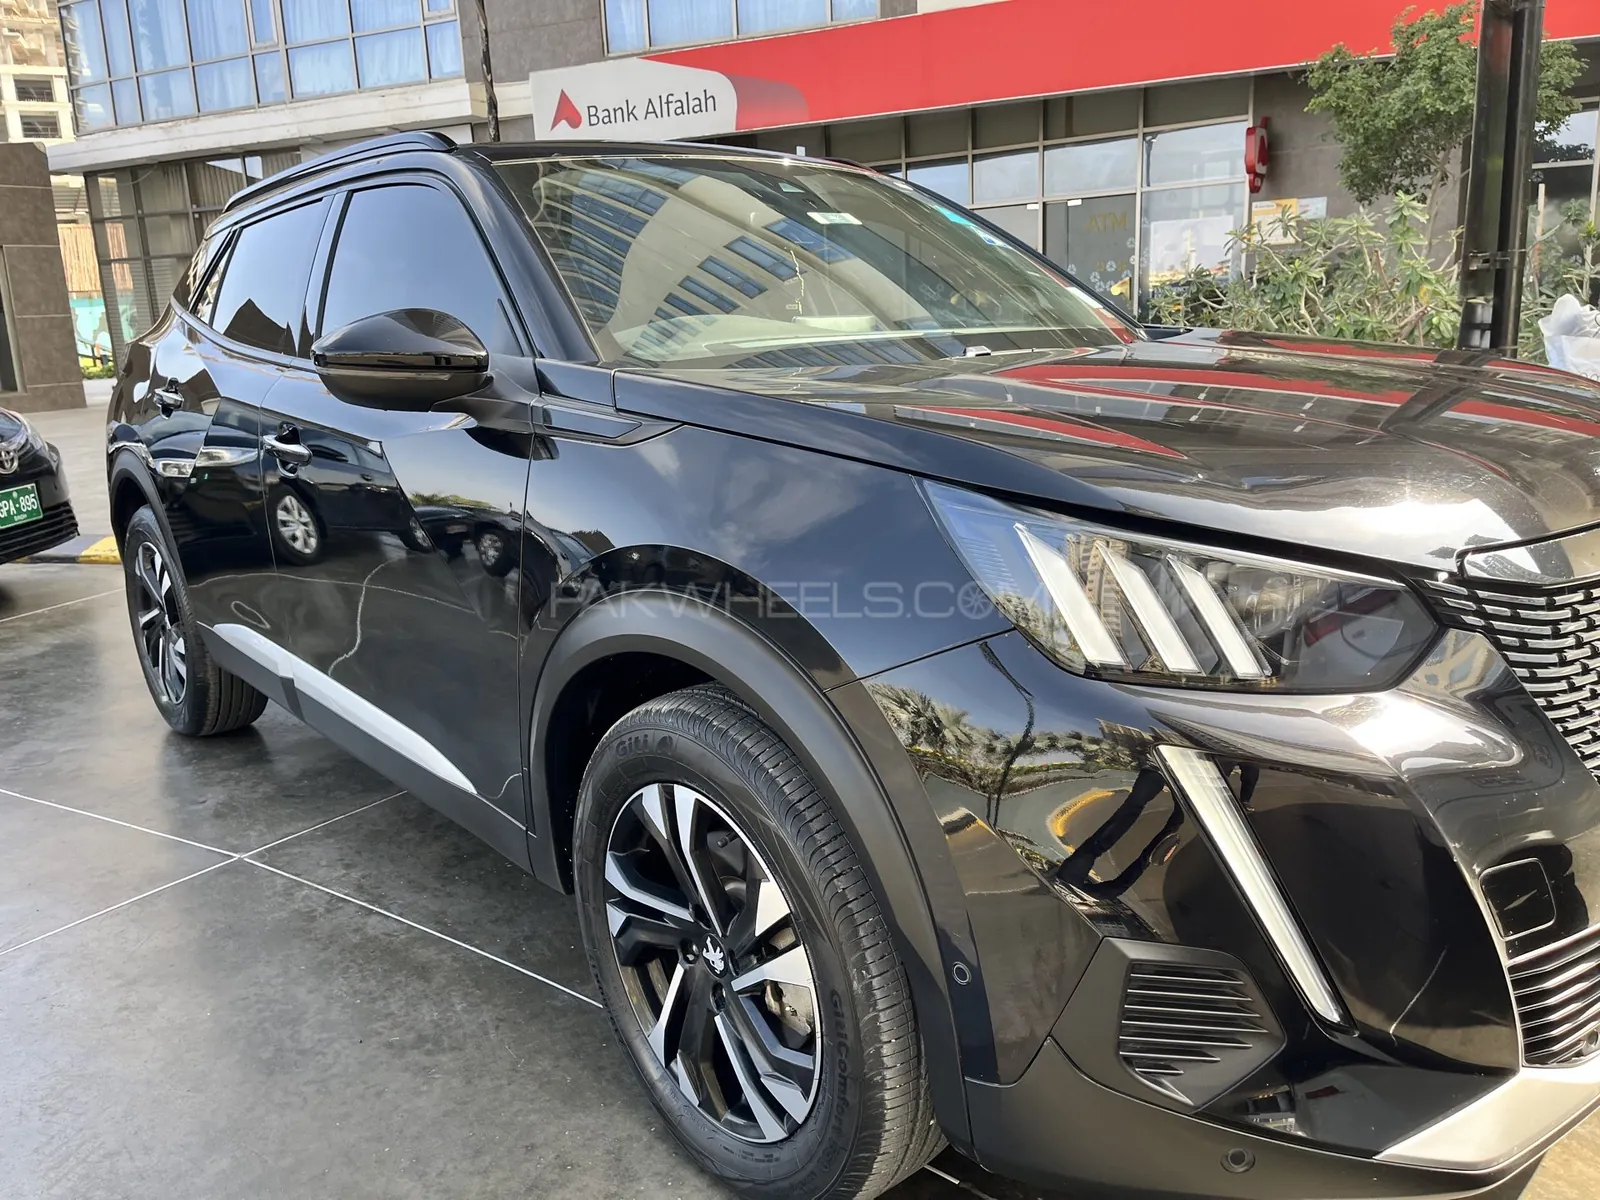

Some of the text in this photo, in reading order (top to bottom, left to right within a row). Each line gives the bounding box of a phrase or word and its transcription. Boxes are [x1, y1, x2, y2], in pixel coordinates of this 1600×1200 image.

[586, 88, 717, 127] Bank Alfalah
[1088, 212, 1127, 232] ATM
[615, 733, 649, 757] Giti
